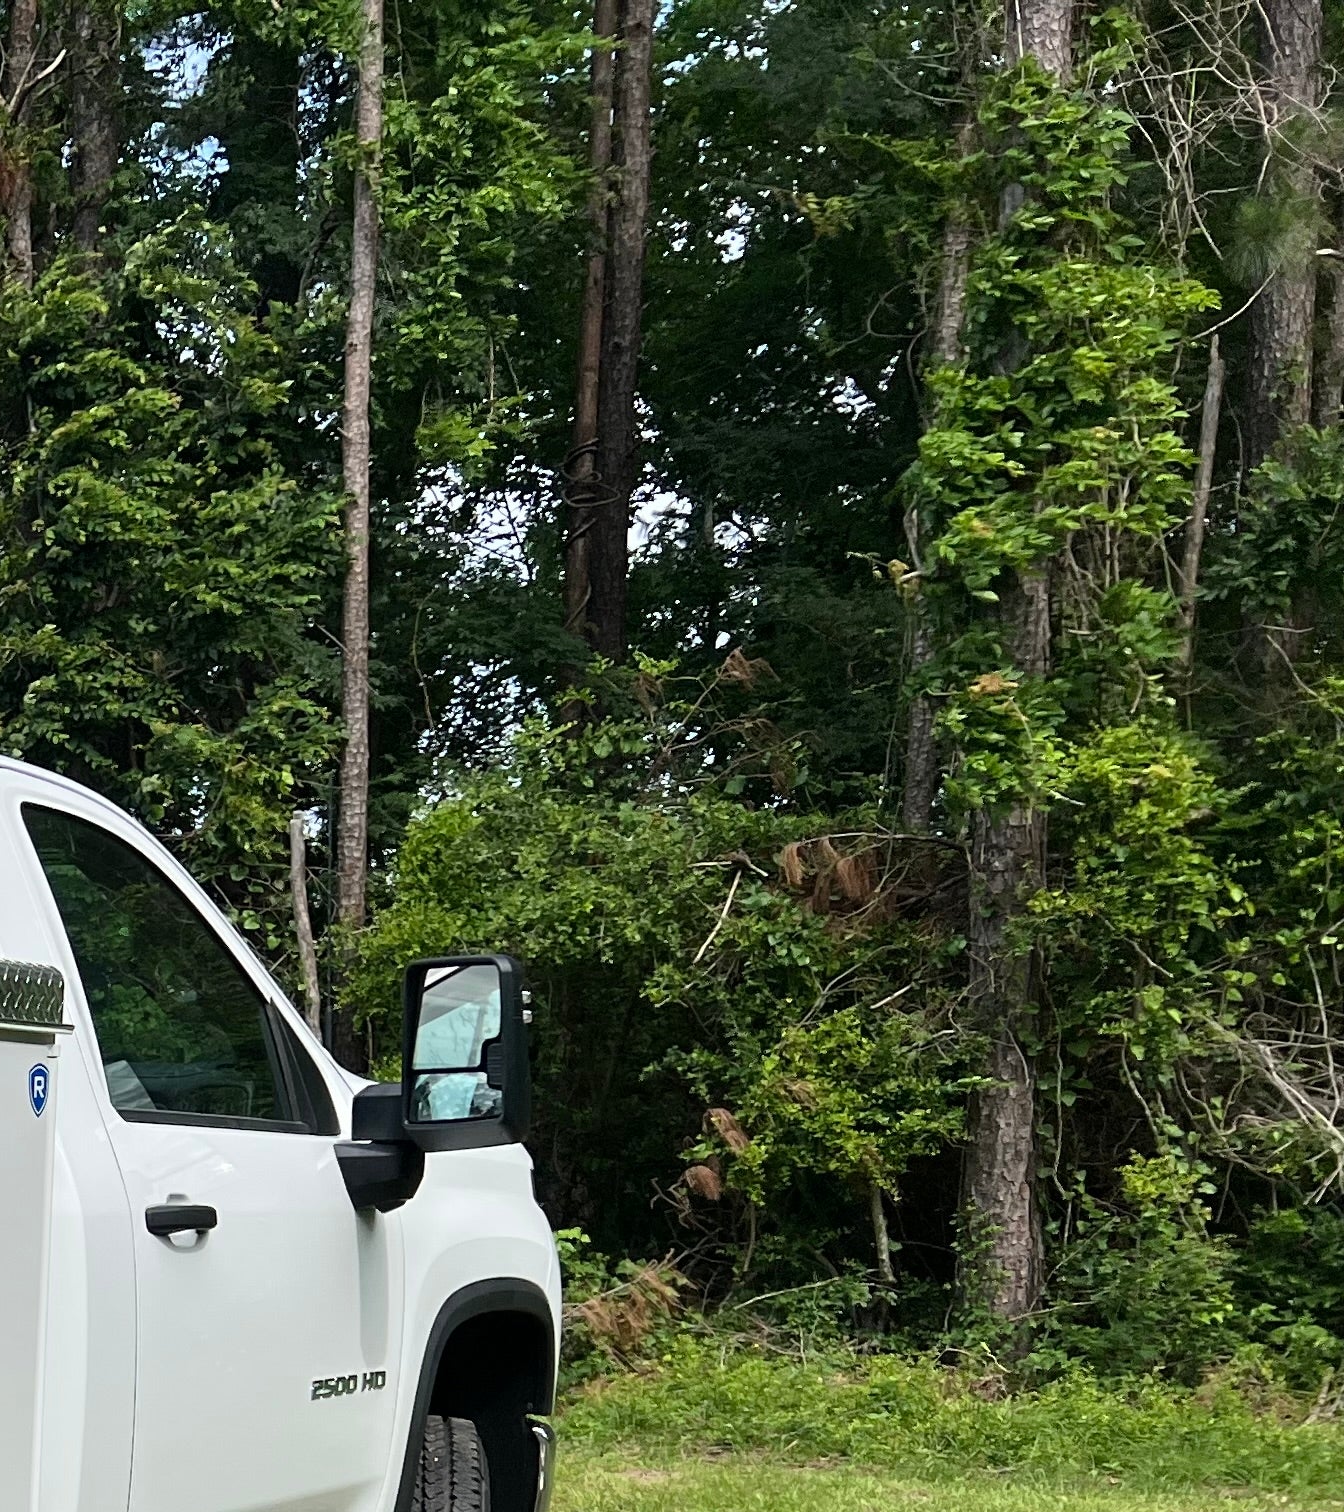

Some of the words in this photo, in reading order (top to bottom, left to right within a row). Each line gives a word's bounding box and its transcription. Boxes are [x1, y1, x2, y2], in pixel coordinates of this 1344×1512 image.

[33, 1075, 45, 1099] R
[311, 1375, 358, 1400] 2500
[361, 1371, 386, 1392] HD
